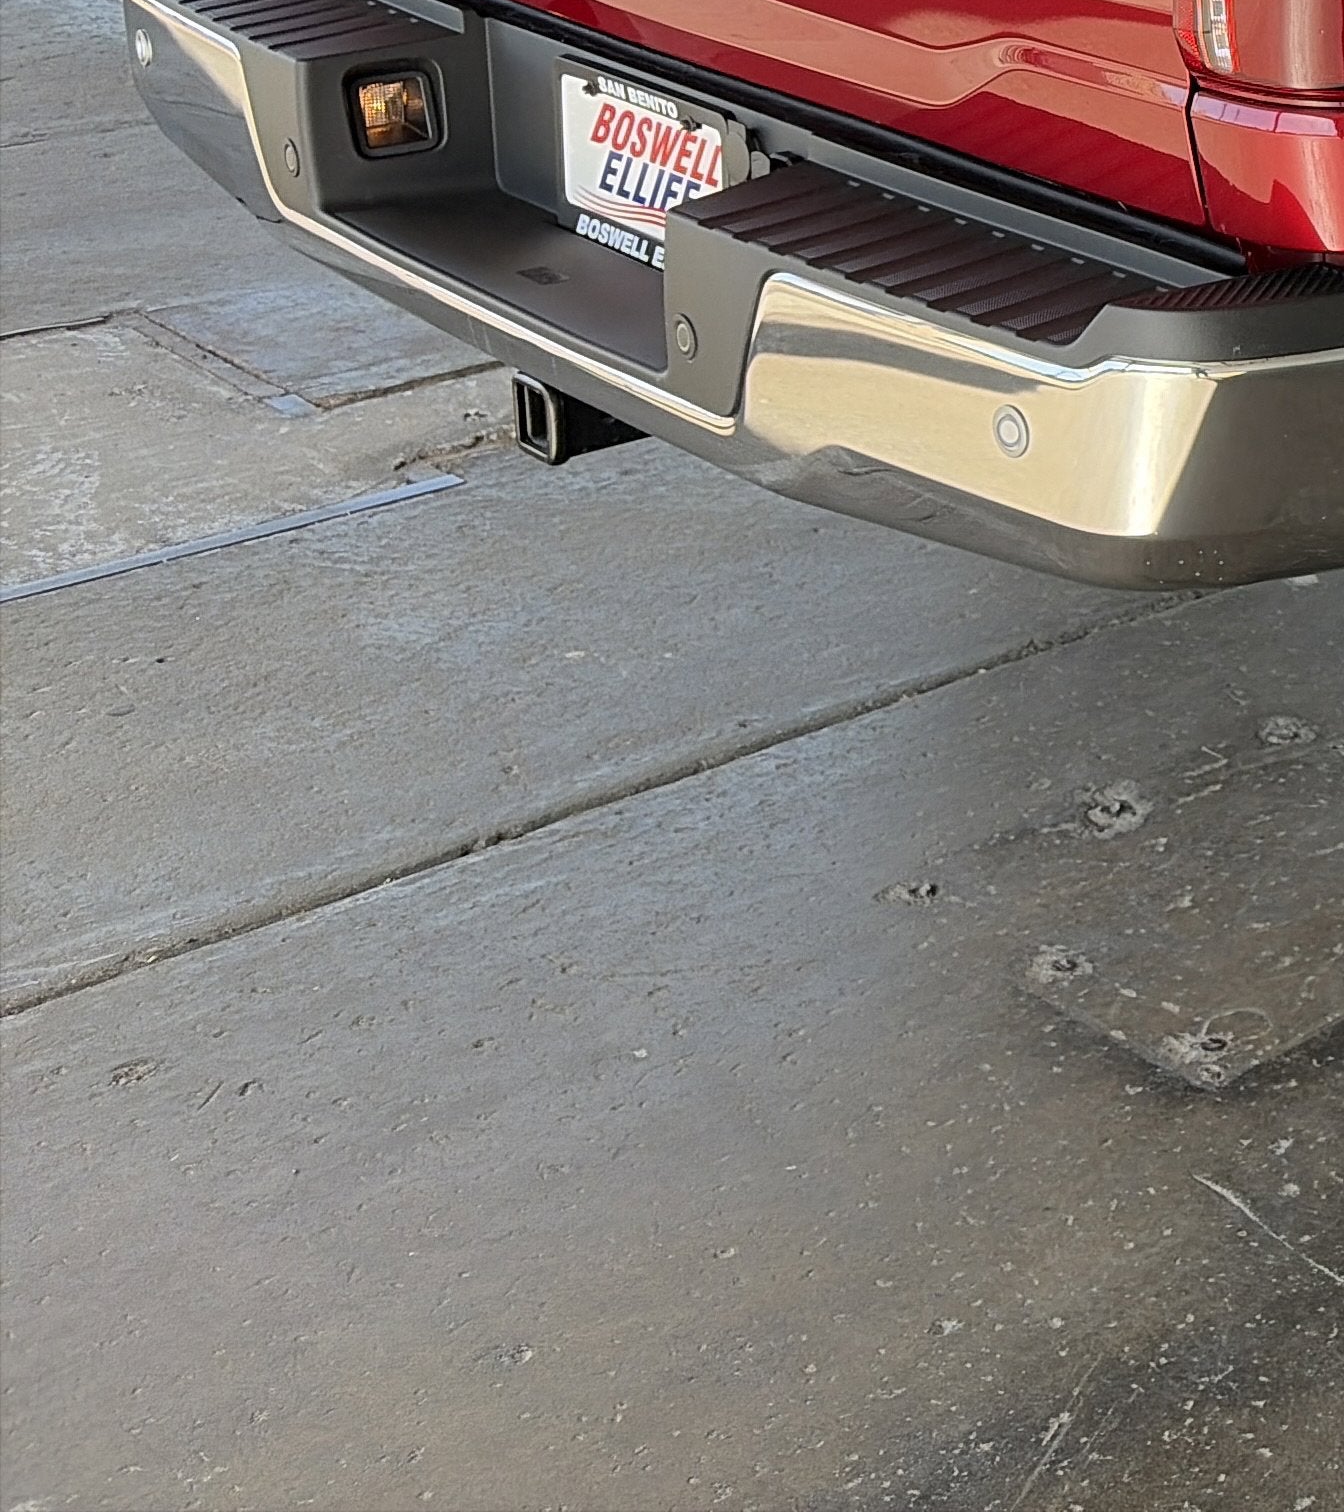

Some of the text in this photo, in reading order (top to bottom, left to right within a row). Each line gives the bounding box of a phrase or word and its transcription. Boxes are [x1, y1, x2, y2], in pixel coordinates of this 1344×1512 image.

[597, 76, 678, 119] SAN BENITO
[590, 102, 722, 188] BOSWELL
[576, 213, 650, 263] BOSWELL
